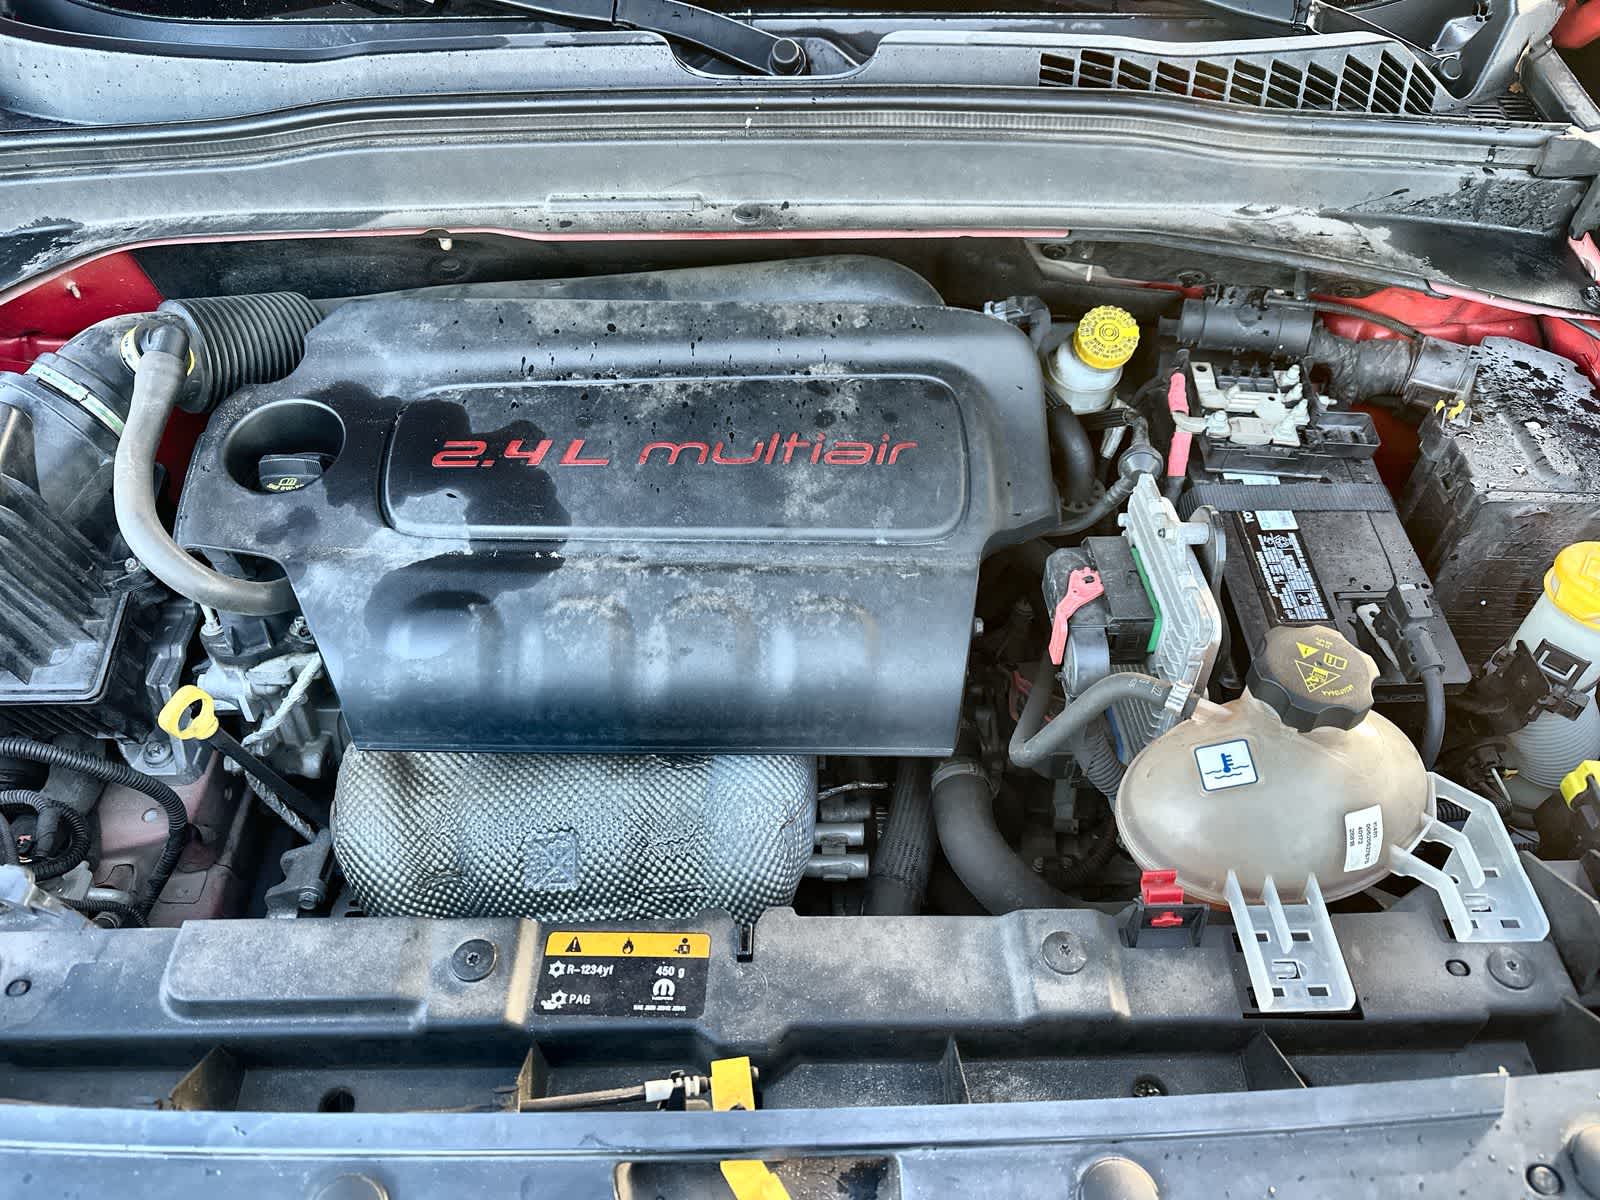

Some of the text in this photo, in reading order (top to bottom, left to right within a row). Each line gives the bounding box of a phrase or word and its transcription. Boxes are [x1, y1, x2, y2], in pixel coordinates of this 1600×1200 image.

[638, 431, 919, 465] multiair
[566, 963, 686, 979] R-1234yf 450 g
[568, 993, 591, 1005] PAG
